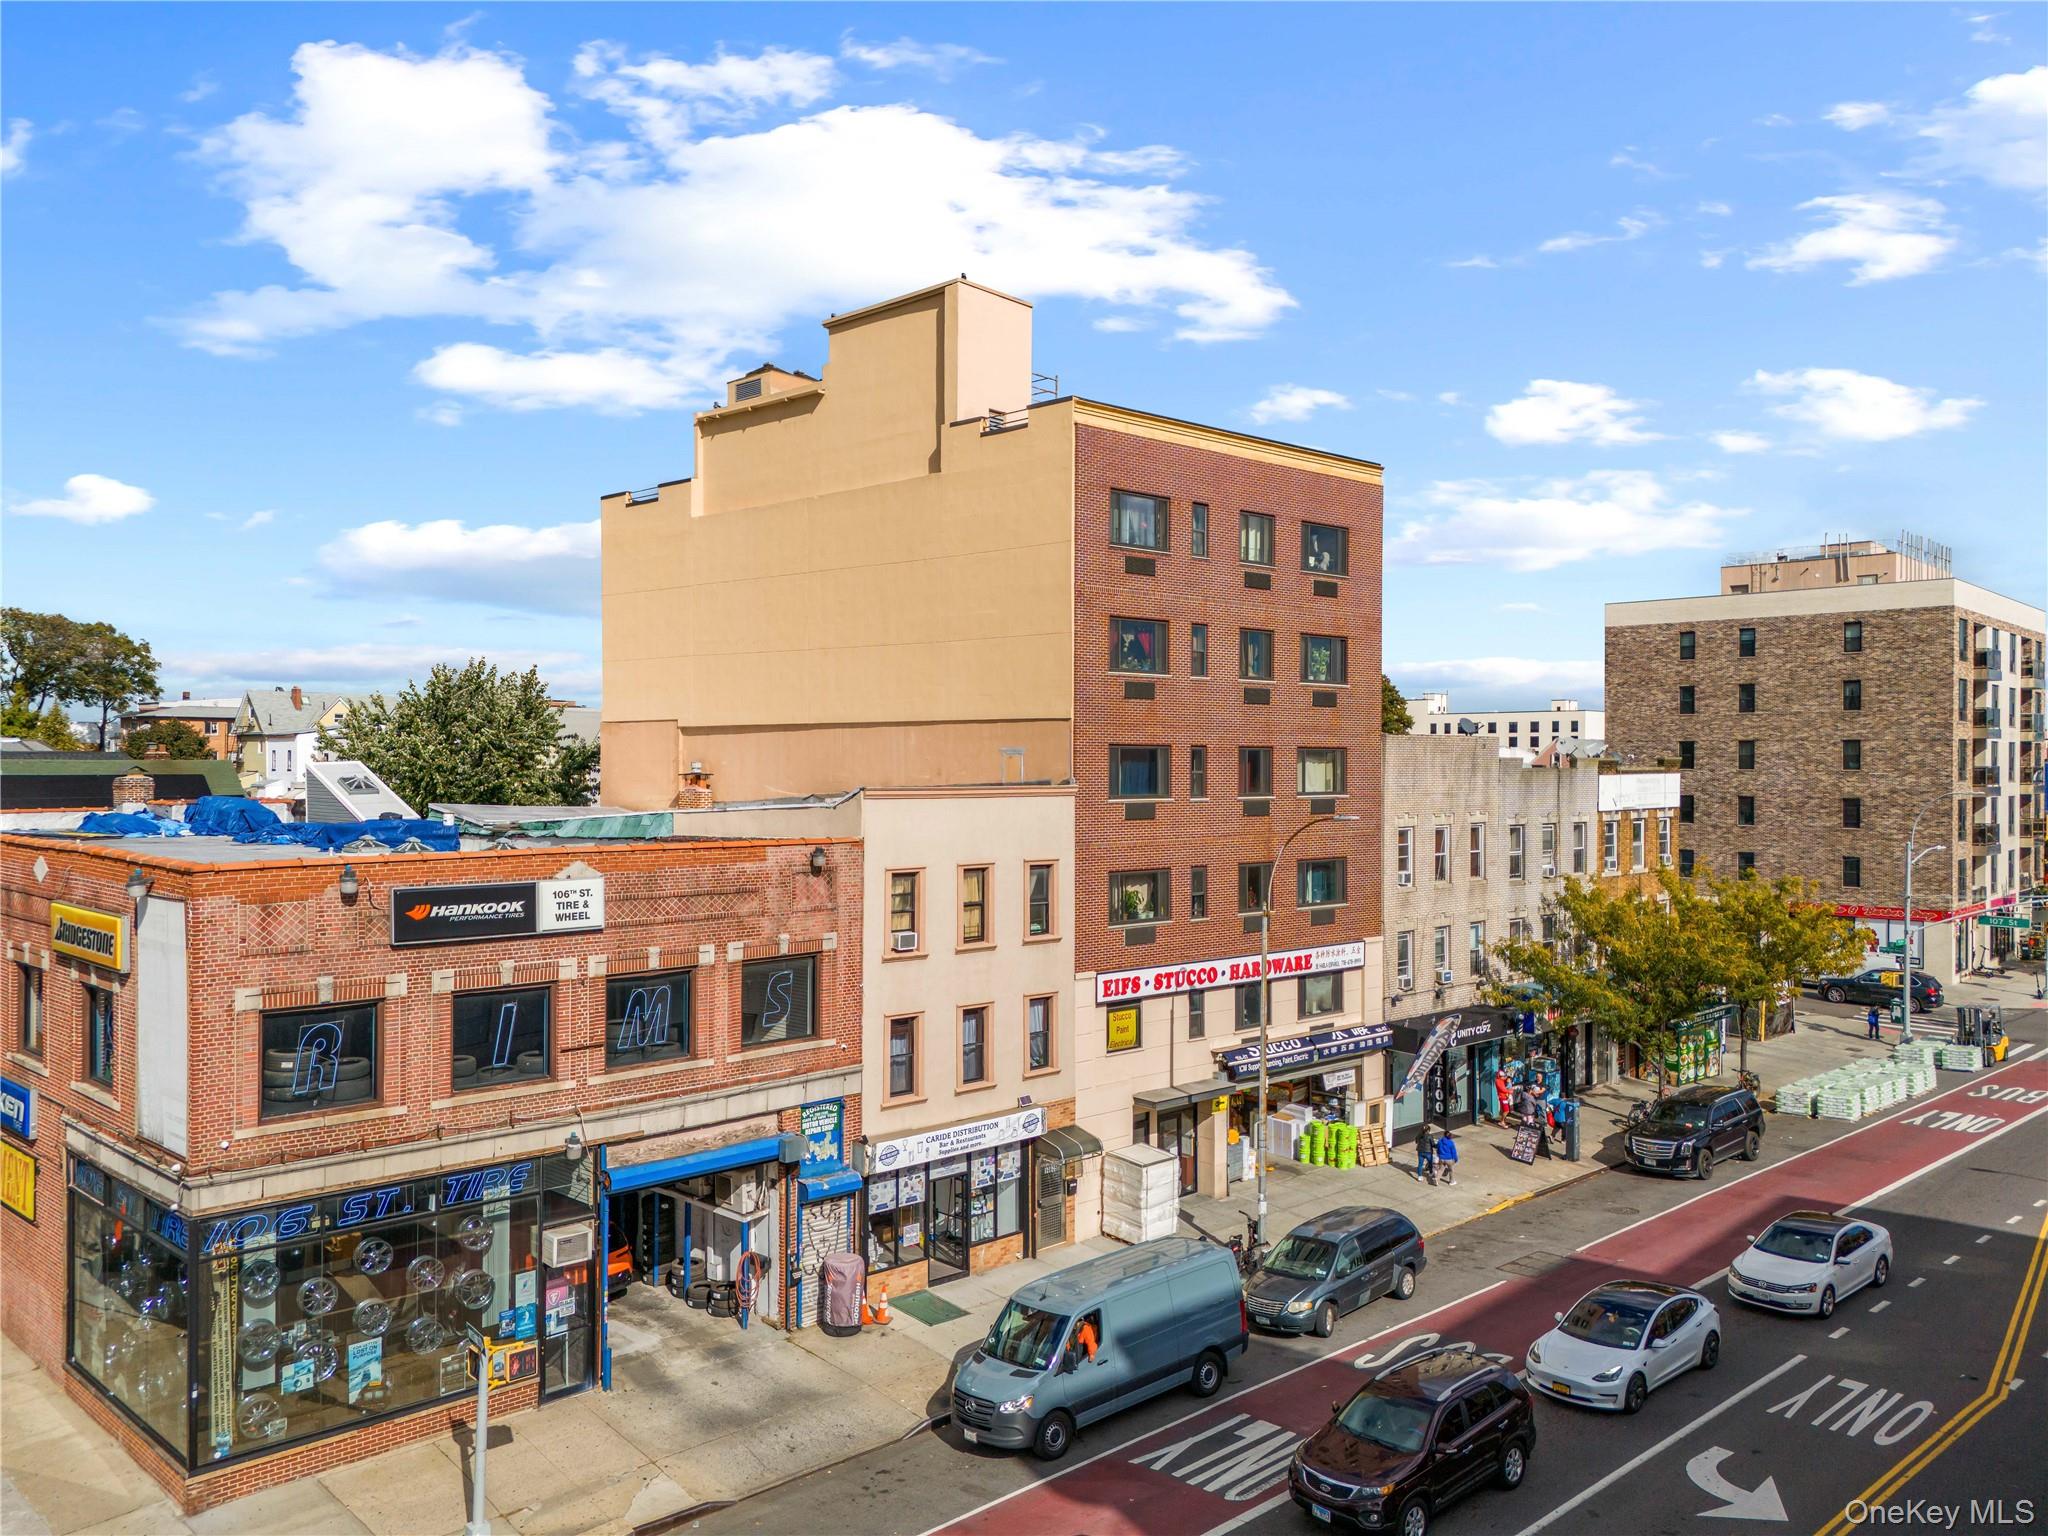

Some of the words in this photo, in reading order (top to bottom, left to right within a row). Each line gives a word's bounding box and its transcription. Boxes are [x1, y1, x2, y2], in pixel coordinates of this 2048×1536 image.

[579, 888, 593, 898] ST.
[556, 901, 580, 910] TIRE
[582, 900, 589, 908] &
[449, 913, 503, 922] PERFORMANCE
[504, 911, 525, 920] TIRES
[555, 911, 590, 922] WHEEL
[54, 917, 115, 956] BRIDGESTONE
[1102, 976, 1141, 997] EIFS
[1153, 967, 1218, 991] STUCCO
[1112, 1012, 1132, 1022] Stucco
[292, 1021, 343, 1096] R
[617, 984, 671, 1050] M
[763, 970, 794, 1028] S
[1116, 1024, 1130, 1035] Paint
[1456, 1027, 1475, 1039] UNITY
[1247, 1039, 1302, 1057] SUCCO
[1967, 1084, 2048, 1104] BUS
[801, 1103, 838, 1119] REGISTERED
[801, 1120, 819, 1130] MOTOR
[819, 1116, 838, 1126] VEHICLE
[821, 1123, 835, 1132] SHOP
[1900, 1109, 2006, 1133] ONLY
[925, 1131, 951, 1144] CARIDE
[952, 1121, 999, 1138] DISTRIBUTION
[955, 1133, 986, 1144] Restaurants
[938, 1147, 959, 1156] Supplies
[960, 1142, 969, 1150] and
[204, 1205, 313, 1252] 106
[338, 1187, 414, 1227] ST.
[447, 1162, 531, 1204] TIRE
[1766, 1374, 1935, 1446] ONLY
